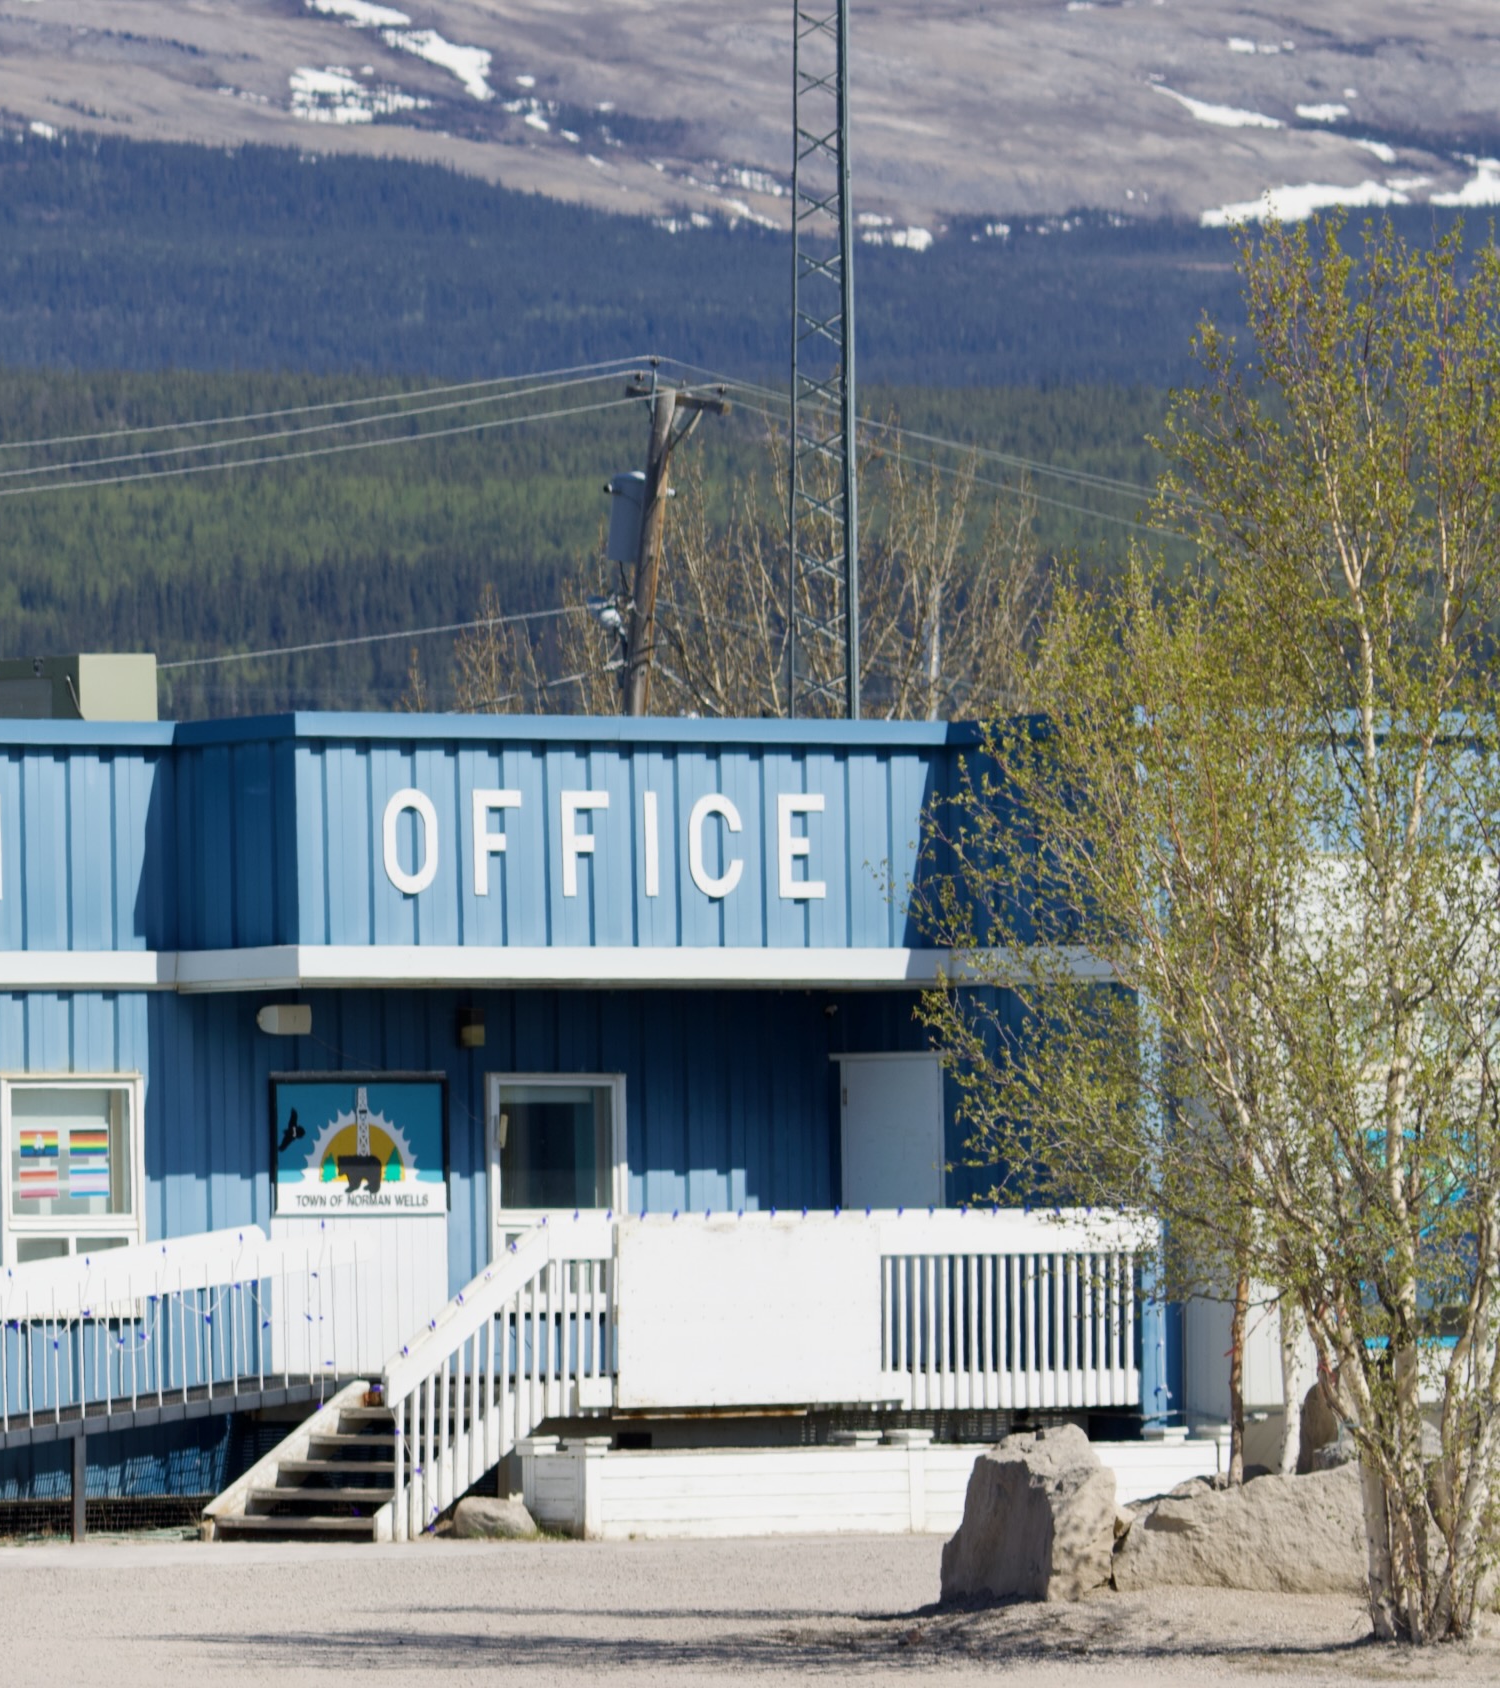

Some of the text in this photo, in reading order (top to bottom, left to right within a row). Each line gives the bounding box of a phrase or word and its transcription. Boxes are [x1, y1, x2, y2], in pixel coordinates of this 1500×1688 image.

[382, 788, 826, 899] OFFICE
[296, 1193, 429, 1207] TOWN OF NORMAN WELLS
